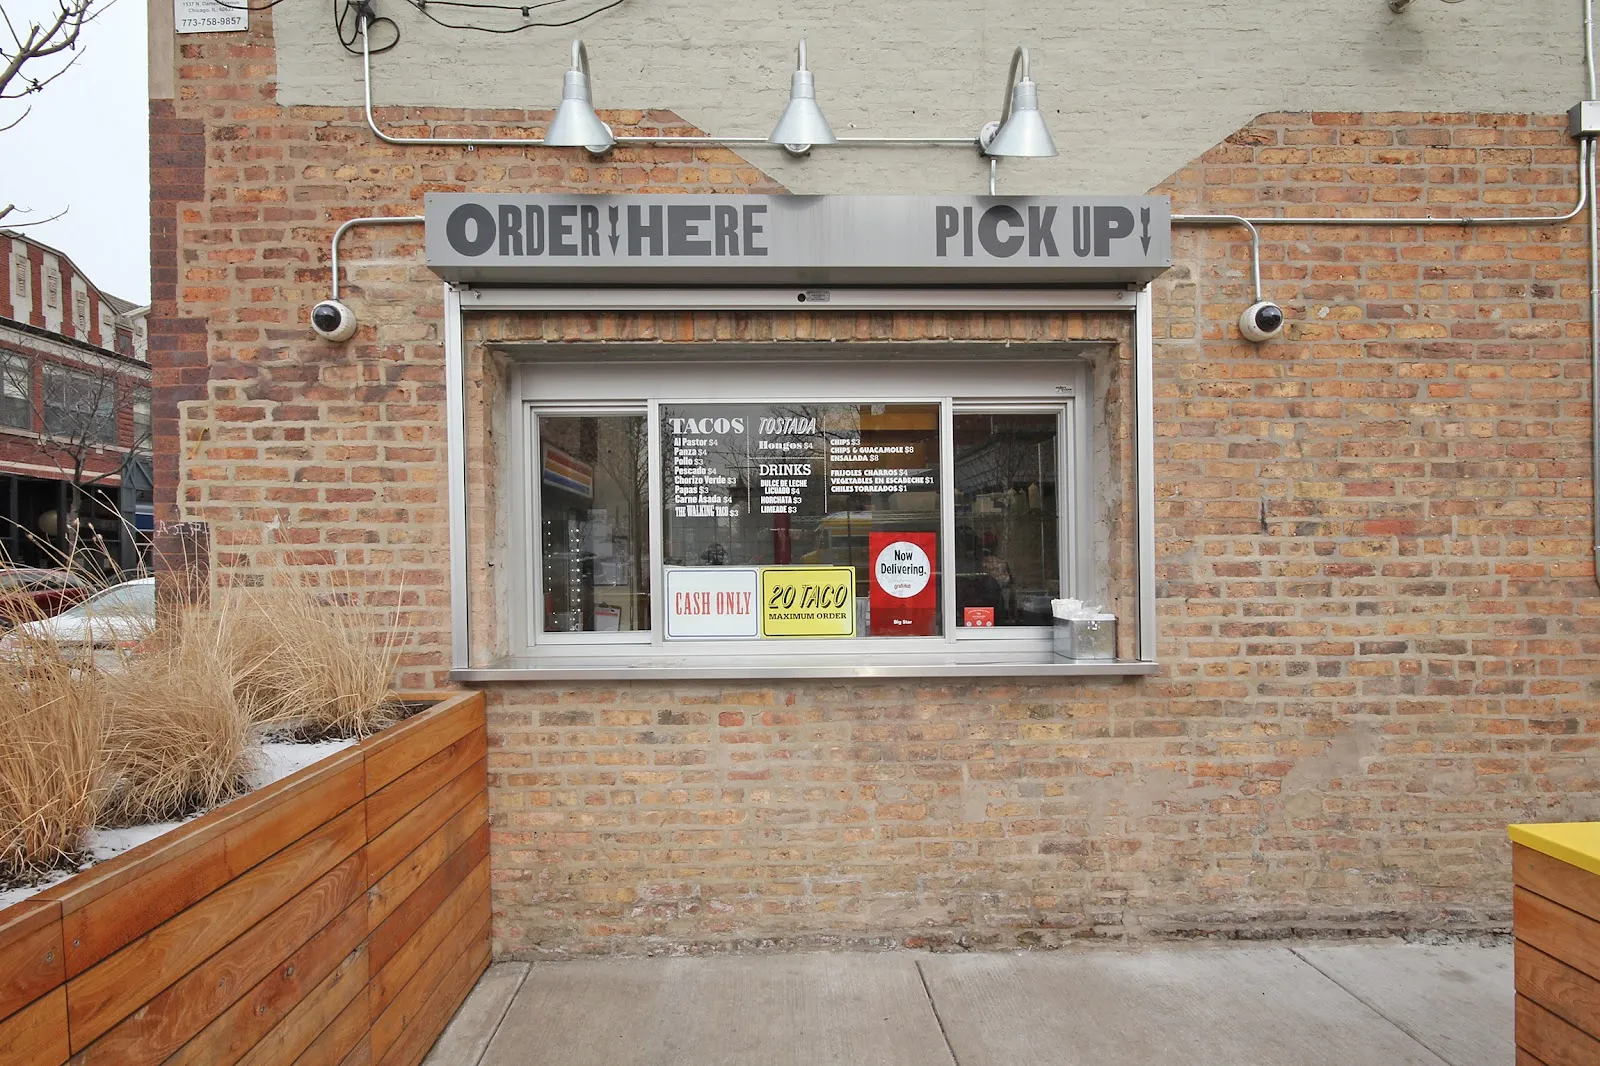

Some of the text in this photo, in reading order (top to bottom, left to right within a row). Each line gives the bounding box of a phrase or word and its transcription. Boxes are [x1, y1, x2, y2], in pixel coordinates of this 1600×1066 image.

[182, 17, 241, 27] 773-758-9857
[446, 203, 768, 257] ORDER HERE
[936, 204, 1135, 258] PICK UP
[669, 417, 744, 434] TACOS
[759, 416, 816, 435] TOSTADA
[674, 437, 681, 446] Al
[682, 437, 707, 446] Pastor
[759, 441, 813, 451] Hongos $4
[674, 447, 707, 456] Panza $4
[904, 446, 914, 454] $8
[674, 457, 704, 466] Pollo $3
[869, 454, 879, 462] $8
[675, 466, 716, 475] Pescado $4
[759, 464, 811, 476] DRINKS
[675, 475, 703, 484] Chorizo
[704, 475, 726, 484] Verde
[760, 479, 808, 487] DULCE DE LECHE
[925, 476, 934, 484] $1
[675, 485, 709, 496] Papas $3
[854, 485, 898, 493] TORREADOS
[675, 495, 733, 504] Carne Asada $4
[761, 496, 792, 504] HORCHATA
[675, 505, 739, 517] THE WALKING TACO $3
[761, 505, 797, 514] LIMEADE $3
[894, 550, 913, 561] Now
[881, 563, 927, 576] Delivering.
[768, 584, 848, 609] 20 TACO
[675, 592, 752, 615] CASH ONLY
